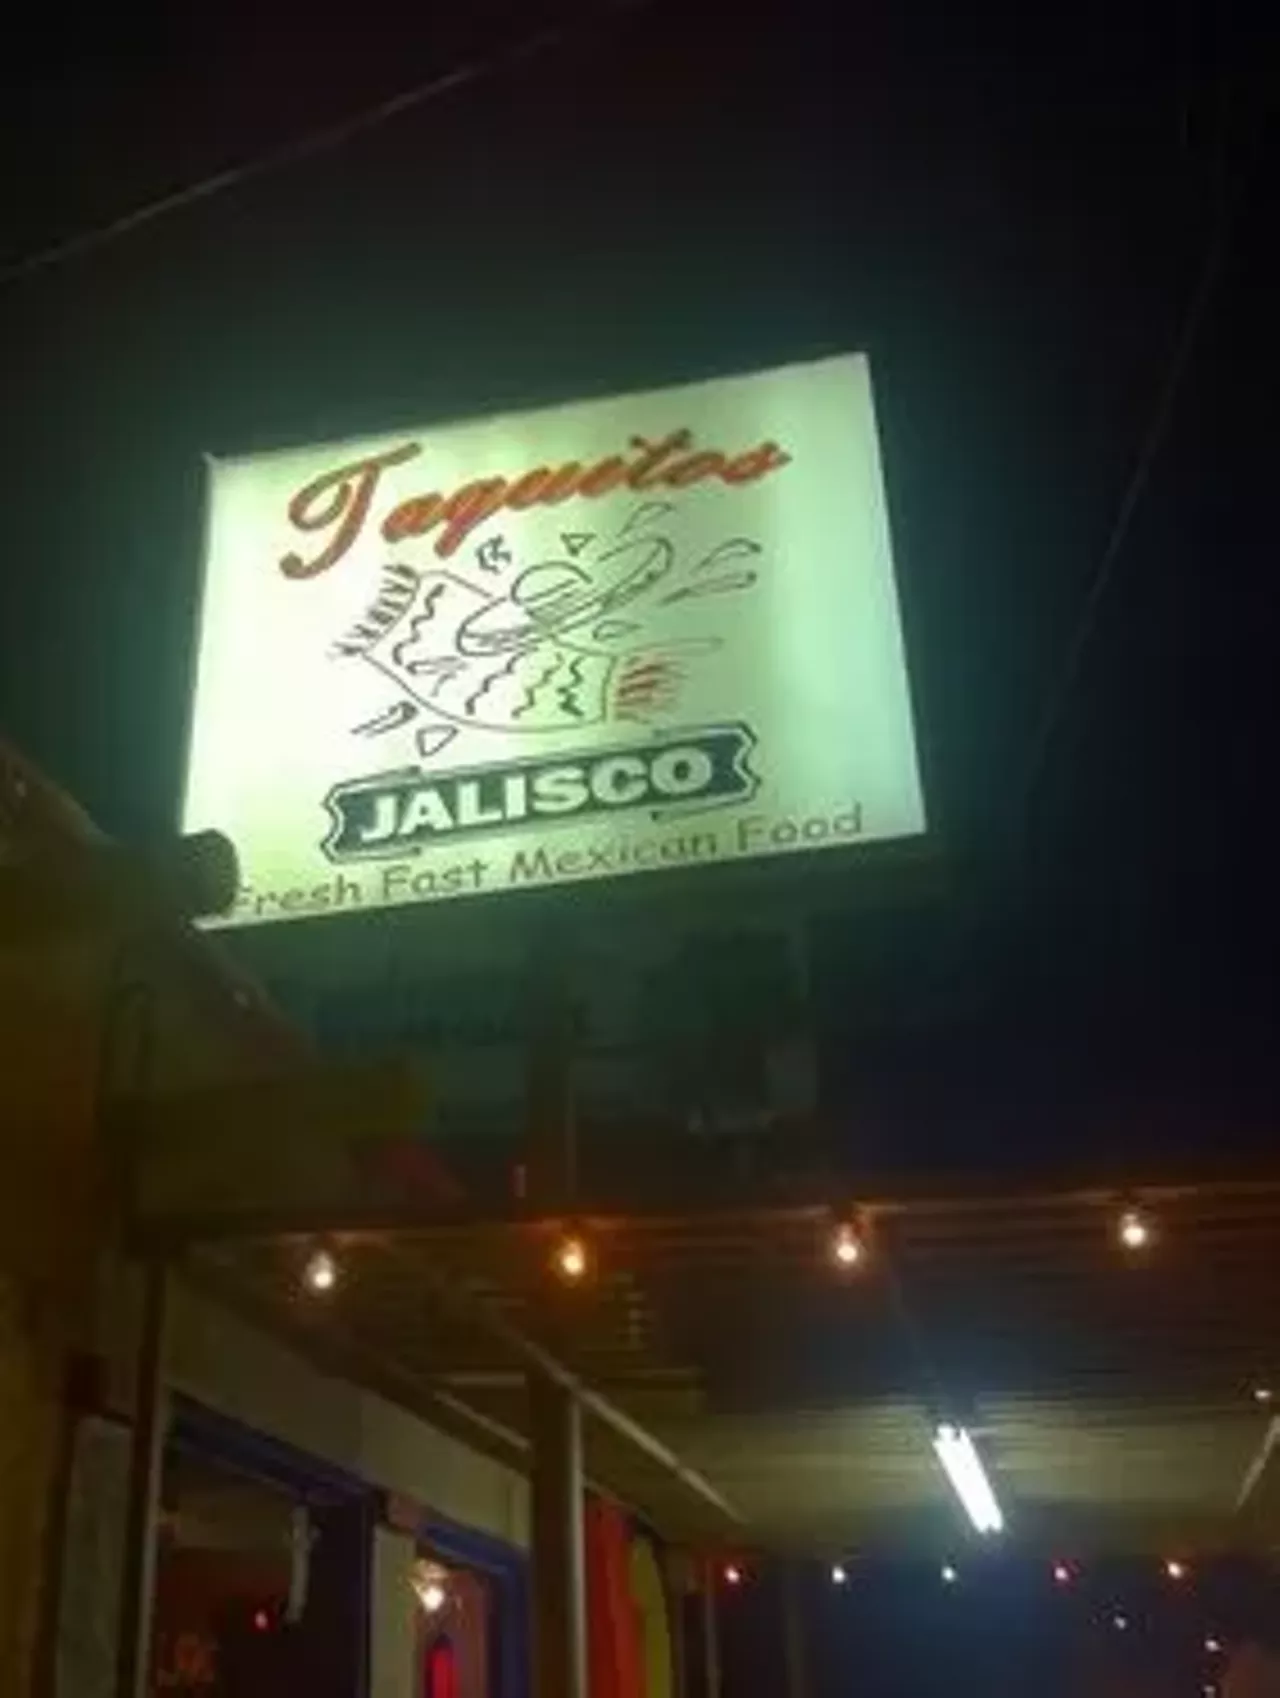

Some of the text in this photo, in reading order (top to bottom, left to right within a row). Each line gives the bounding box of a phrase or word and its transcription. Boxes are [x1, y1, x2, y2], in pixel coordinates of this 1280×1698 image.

[279, 428, 792, 580] Taquitos
[360, 746, 713, 841] JALISCO
[383, 858, 488, 908] Fast
[510, 828, 718, 883] Mexican
[737, 802, 863, 852] Food
